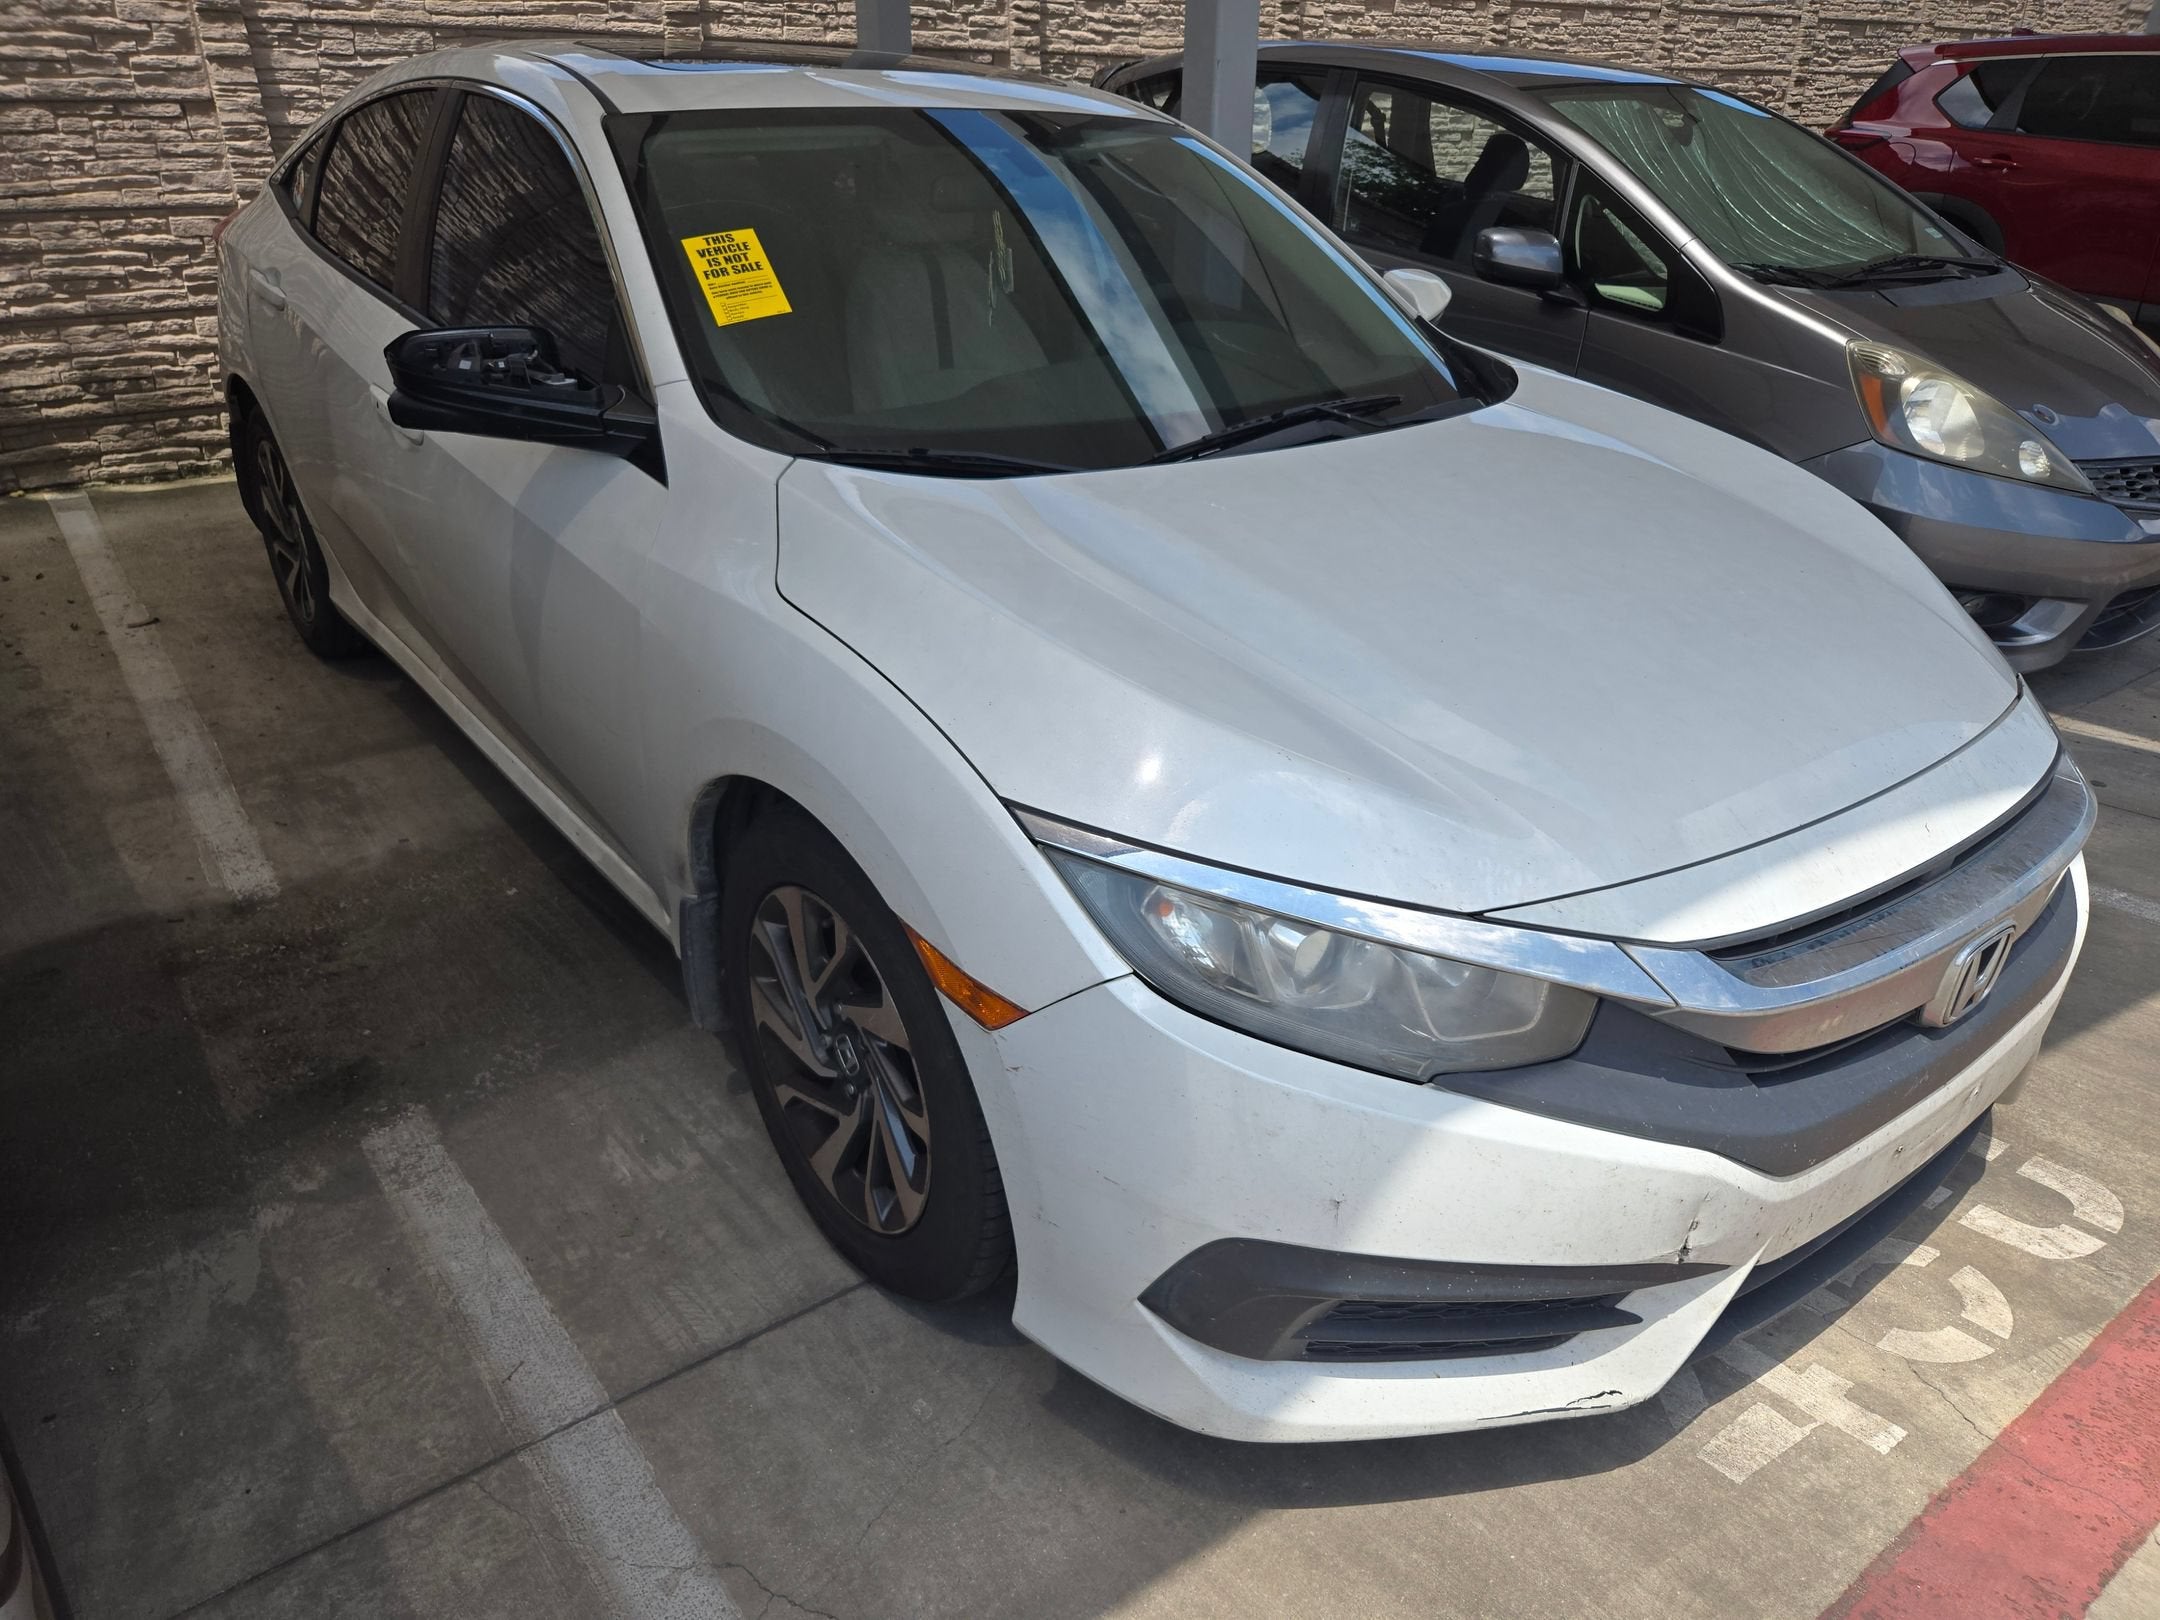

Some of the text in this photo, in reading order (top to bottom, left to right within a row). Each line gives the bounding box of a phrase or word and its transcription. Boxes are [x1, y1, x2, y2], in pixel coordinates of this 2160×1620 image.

[702, 233, 735, 246] THIS
[696, 241, 751, 258] VEHICLE
[706, 252, 749, 268] IS NOT
[703, 261, 764, 280] FOR SALE
